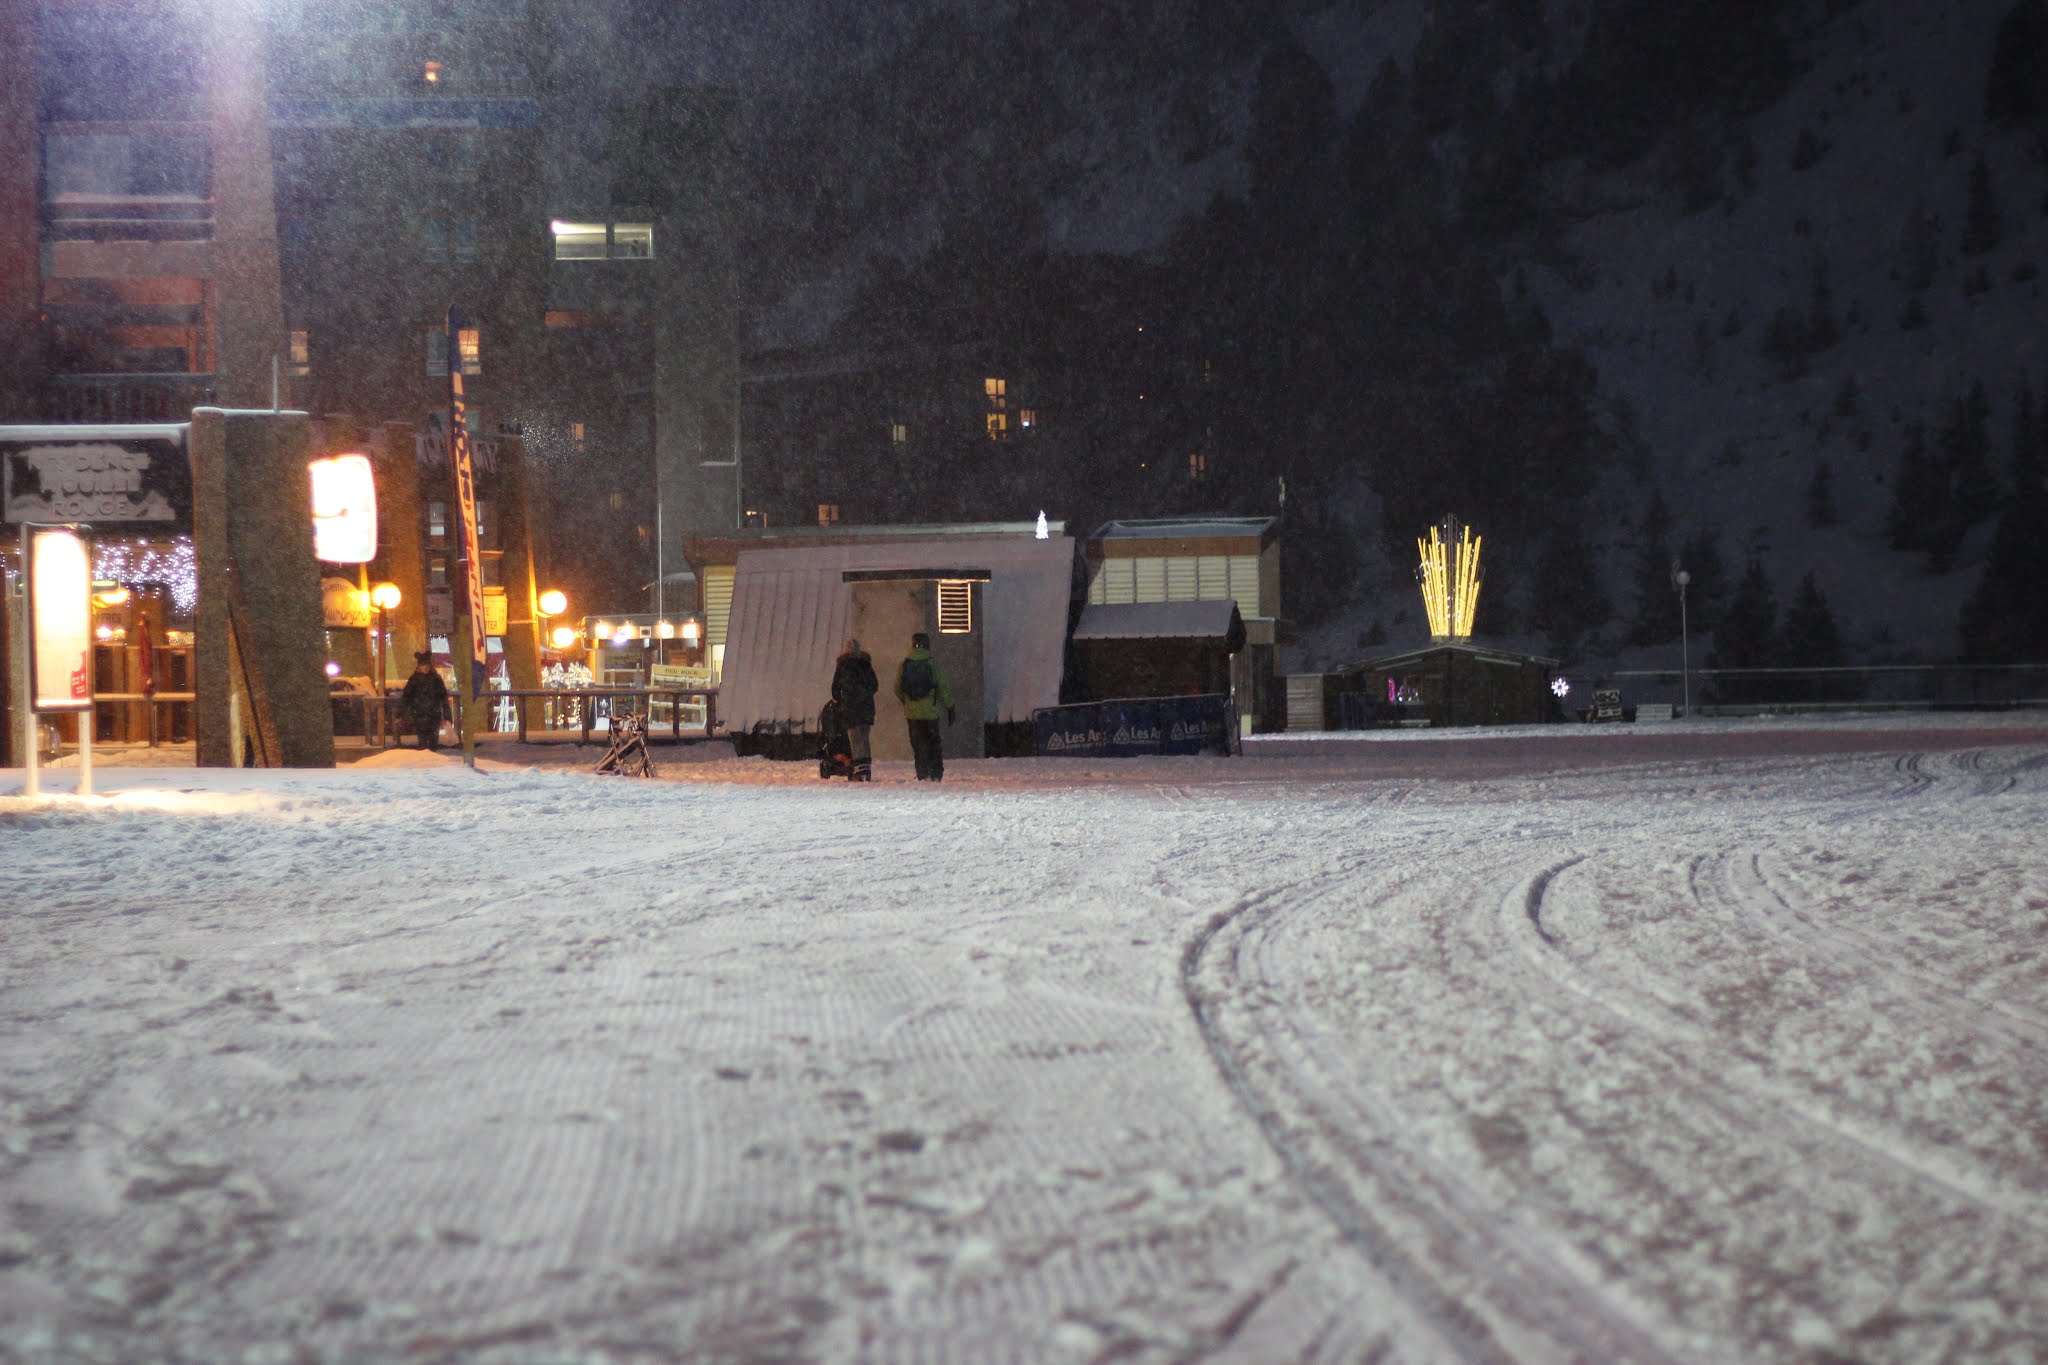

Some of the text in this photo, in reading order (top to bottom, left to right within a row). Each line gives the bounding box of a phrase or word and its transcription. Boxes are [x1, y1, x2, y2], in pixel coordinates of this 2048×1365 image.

[55, 501, 129, 517] ROUGE
[1065, 730, 1085, 744] Les
[1131, 726, 1149, 739] Les
